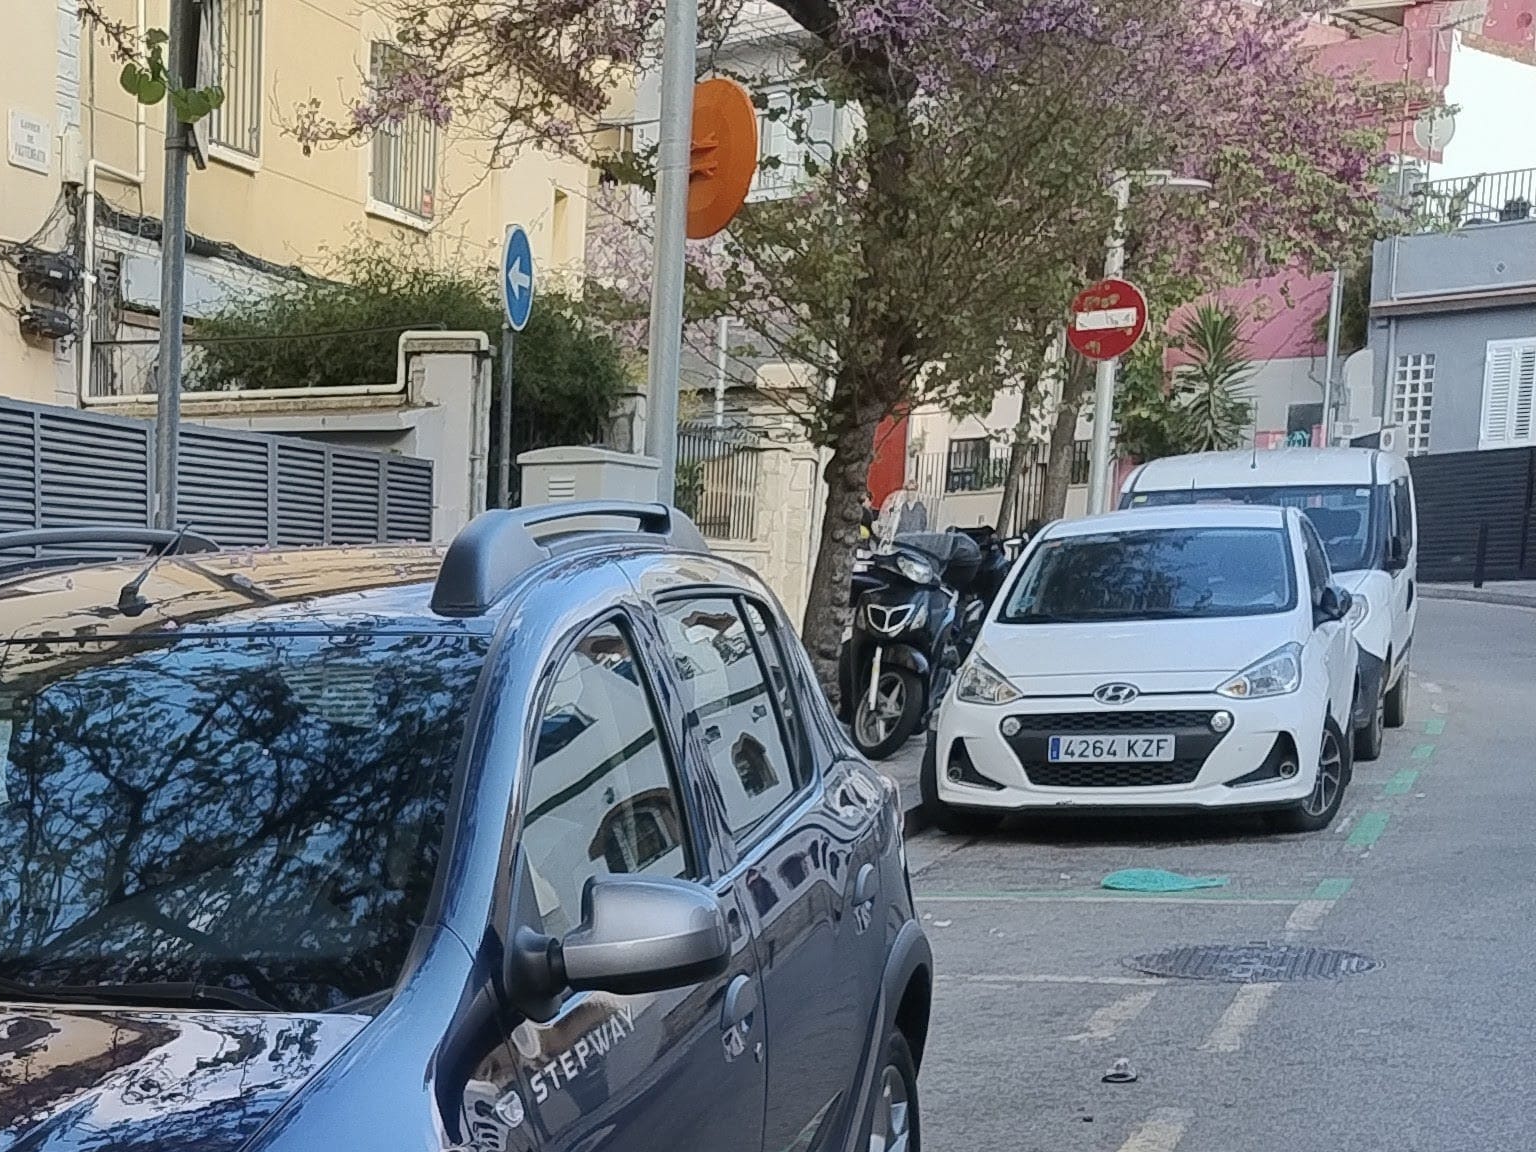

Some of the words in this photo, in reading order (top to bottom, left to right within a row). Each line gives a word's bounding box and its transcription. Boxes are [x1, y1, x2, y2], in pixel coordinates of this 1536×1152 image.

[1064, 739, 1117, 758] 4264
[1127, 739, 1169, 758] KZF
[530, 1003, 635, 1104] STEPWAY
